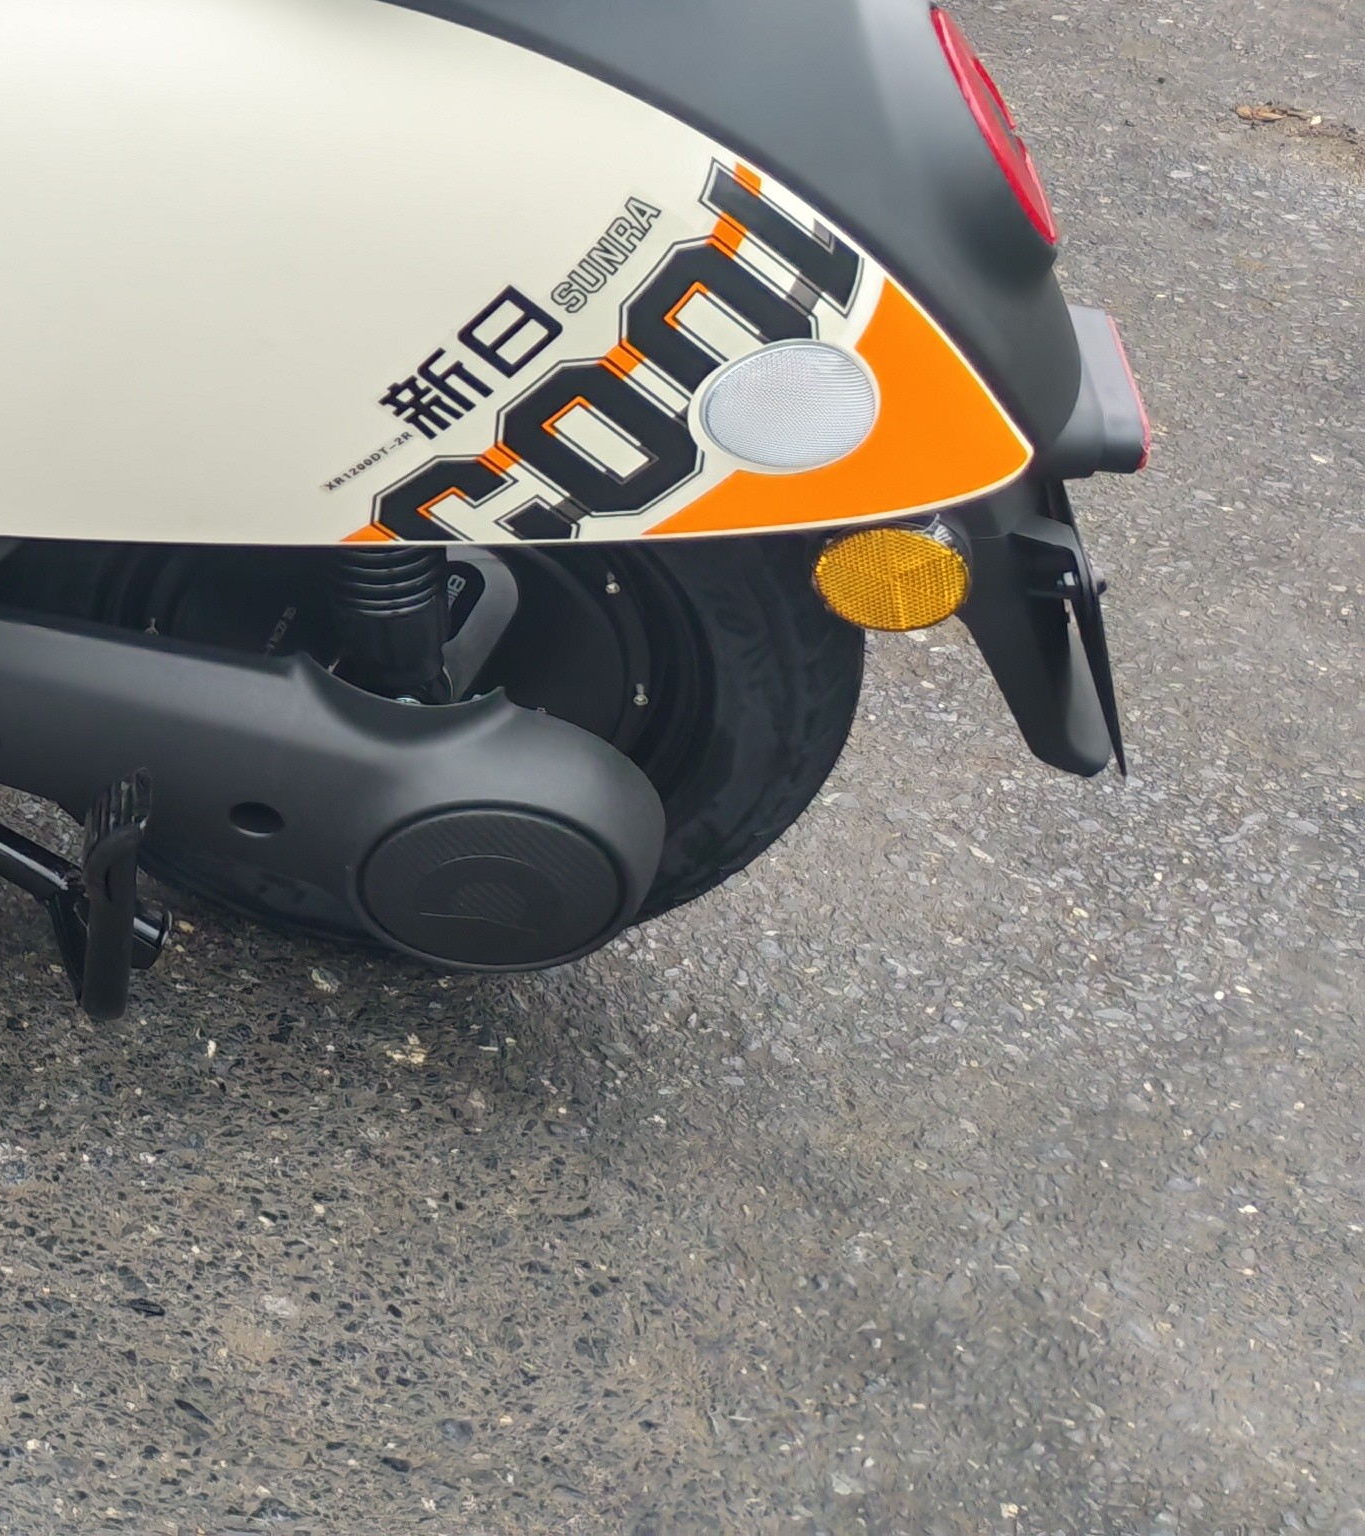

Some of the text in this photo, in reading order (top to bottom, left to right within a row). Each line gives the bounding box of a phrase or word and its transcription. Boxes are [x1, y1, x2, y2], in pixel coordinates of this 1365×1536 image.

[550, 196, 661, 313] SUNRA
[378, 285, 563, 440] 新日
[324, 431, 413, 491] XR1200DT-2R
